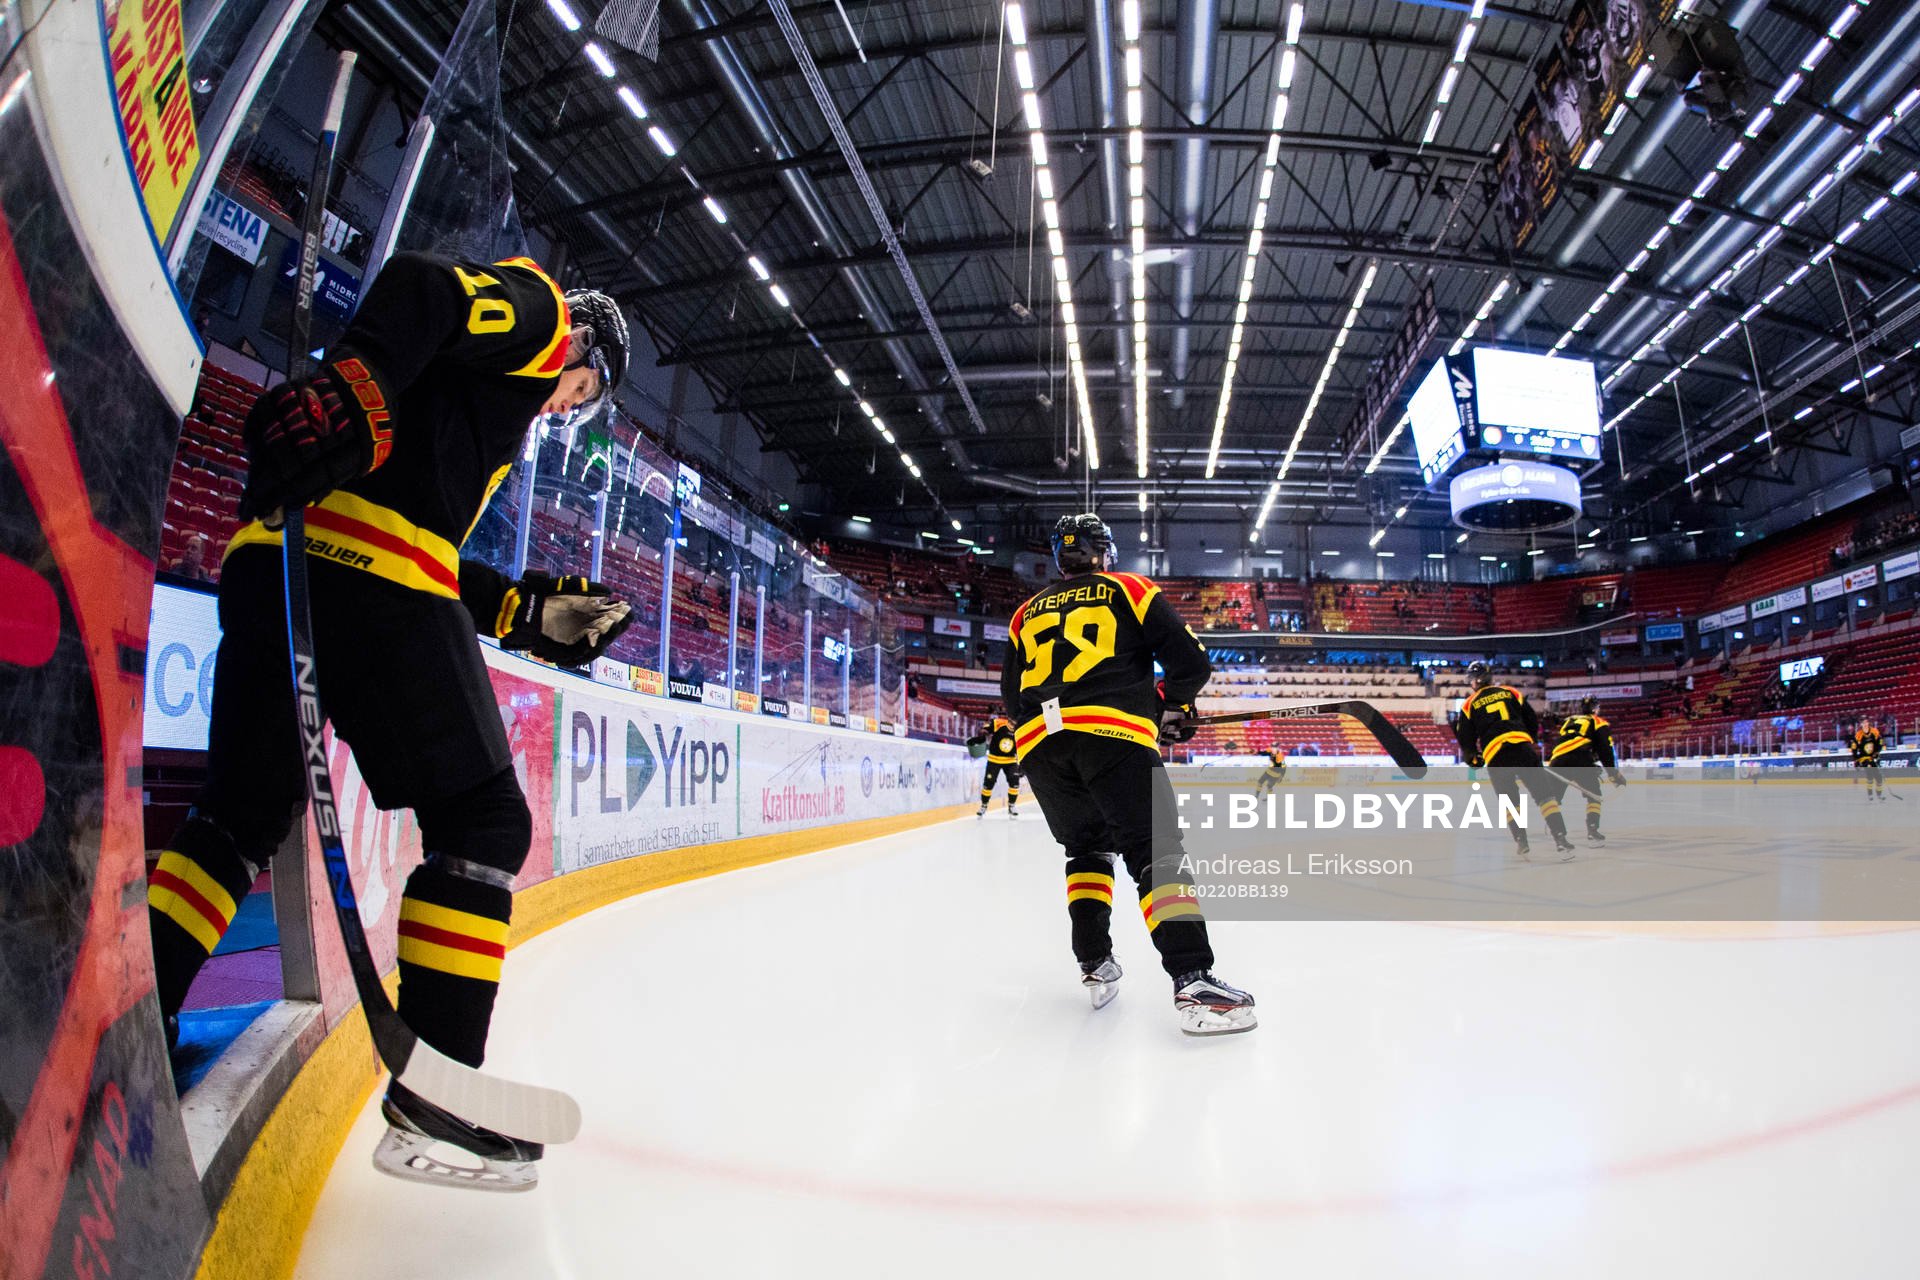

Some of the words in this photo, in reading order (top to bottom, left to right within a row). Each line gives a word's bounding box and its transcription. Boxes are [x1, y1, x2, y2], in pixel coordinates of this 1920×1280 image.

[216, 230, 248, 257] recycling
[325, 290, 349, 310] Electro
[1064, 534, 1075, 545] 59
[1019, 605, 1117, 693] 59
[669, 680, 702, 698] VOLVIA
[763, 700, 788, 715] VOLVIA
[1269, 705, 1319, 720] NEXUS
[1486, 701, 1510, 721] 7
[295, 652, 339, 838] NEXUS
[879, 762, 896, 790] Das
[761, 784, 832, 824] Kraftkonsult
[833, 785, 846, 816] AB
[583, 834, 635, 865] samarbete
[638, 828, 659, 851] med
[661, 826, 681, 849] SEB
[682, 823, 700, 845] och
[701, 821, 722, 843] SHL
